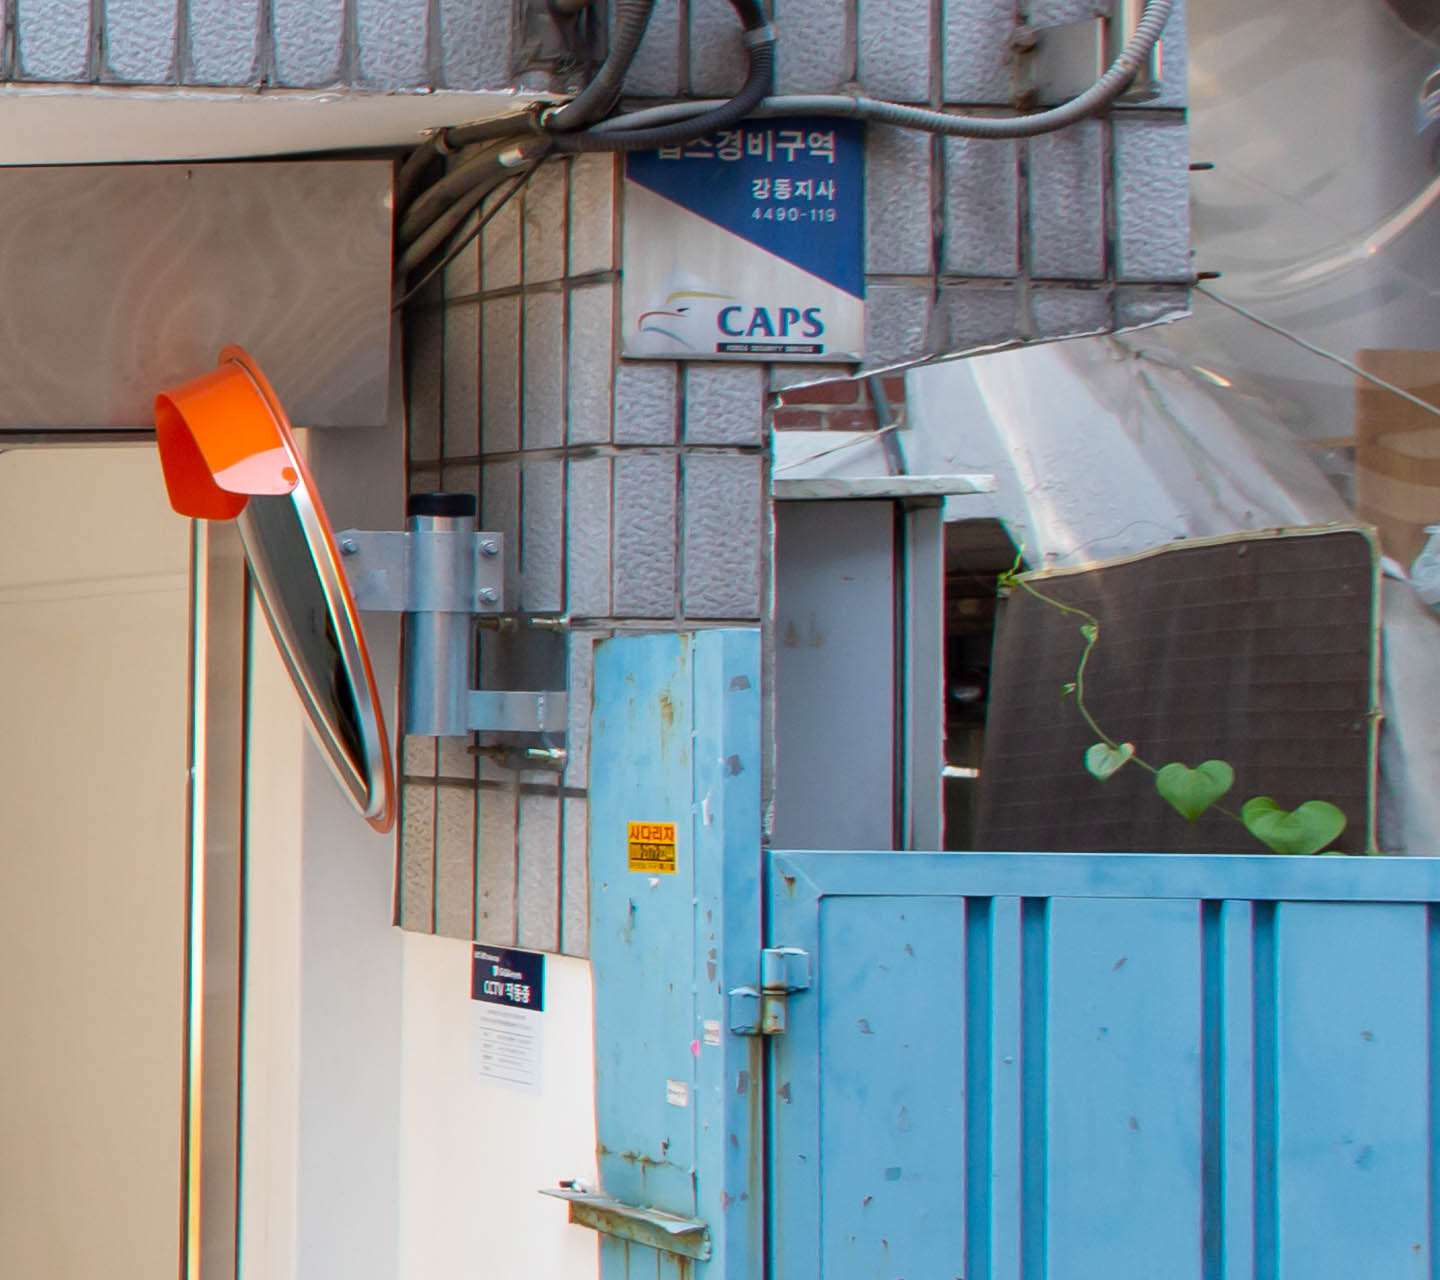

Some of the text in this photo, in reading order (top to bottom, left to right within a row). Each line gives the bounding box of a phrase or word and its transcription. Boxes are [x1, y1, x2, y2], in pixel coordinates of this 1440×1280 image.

[717, 305, 825, 338] CAPS
[483, 980, 532, 1004] CCTV 작동중
